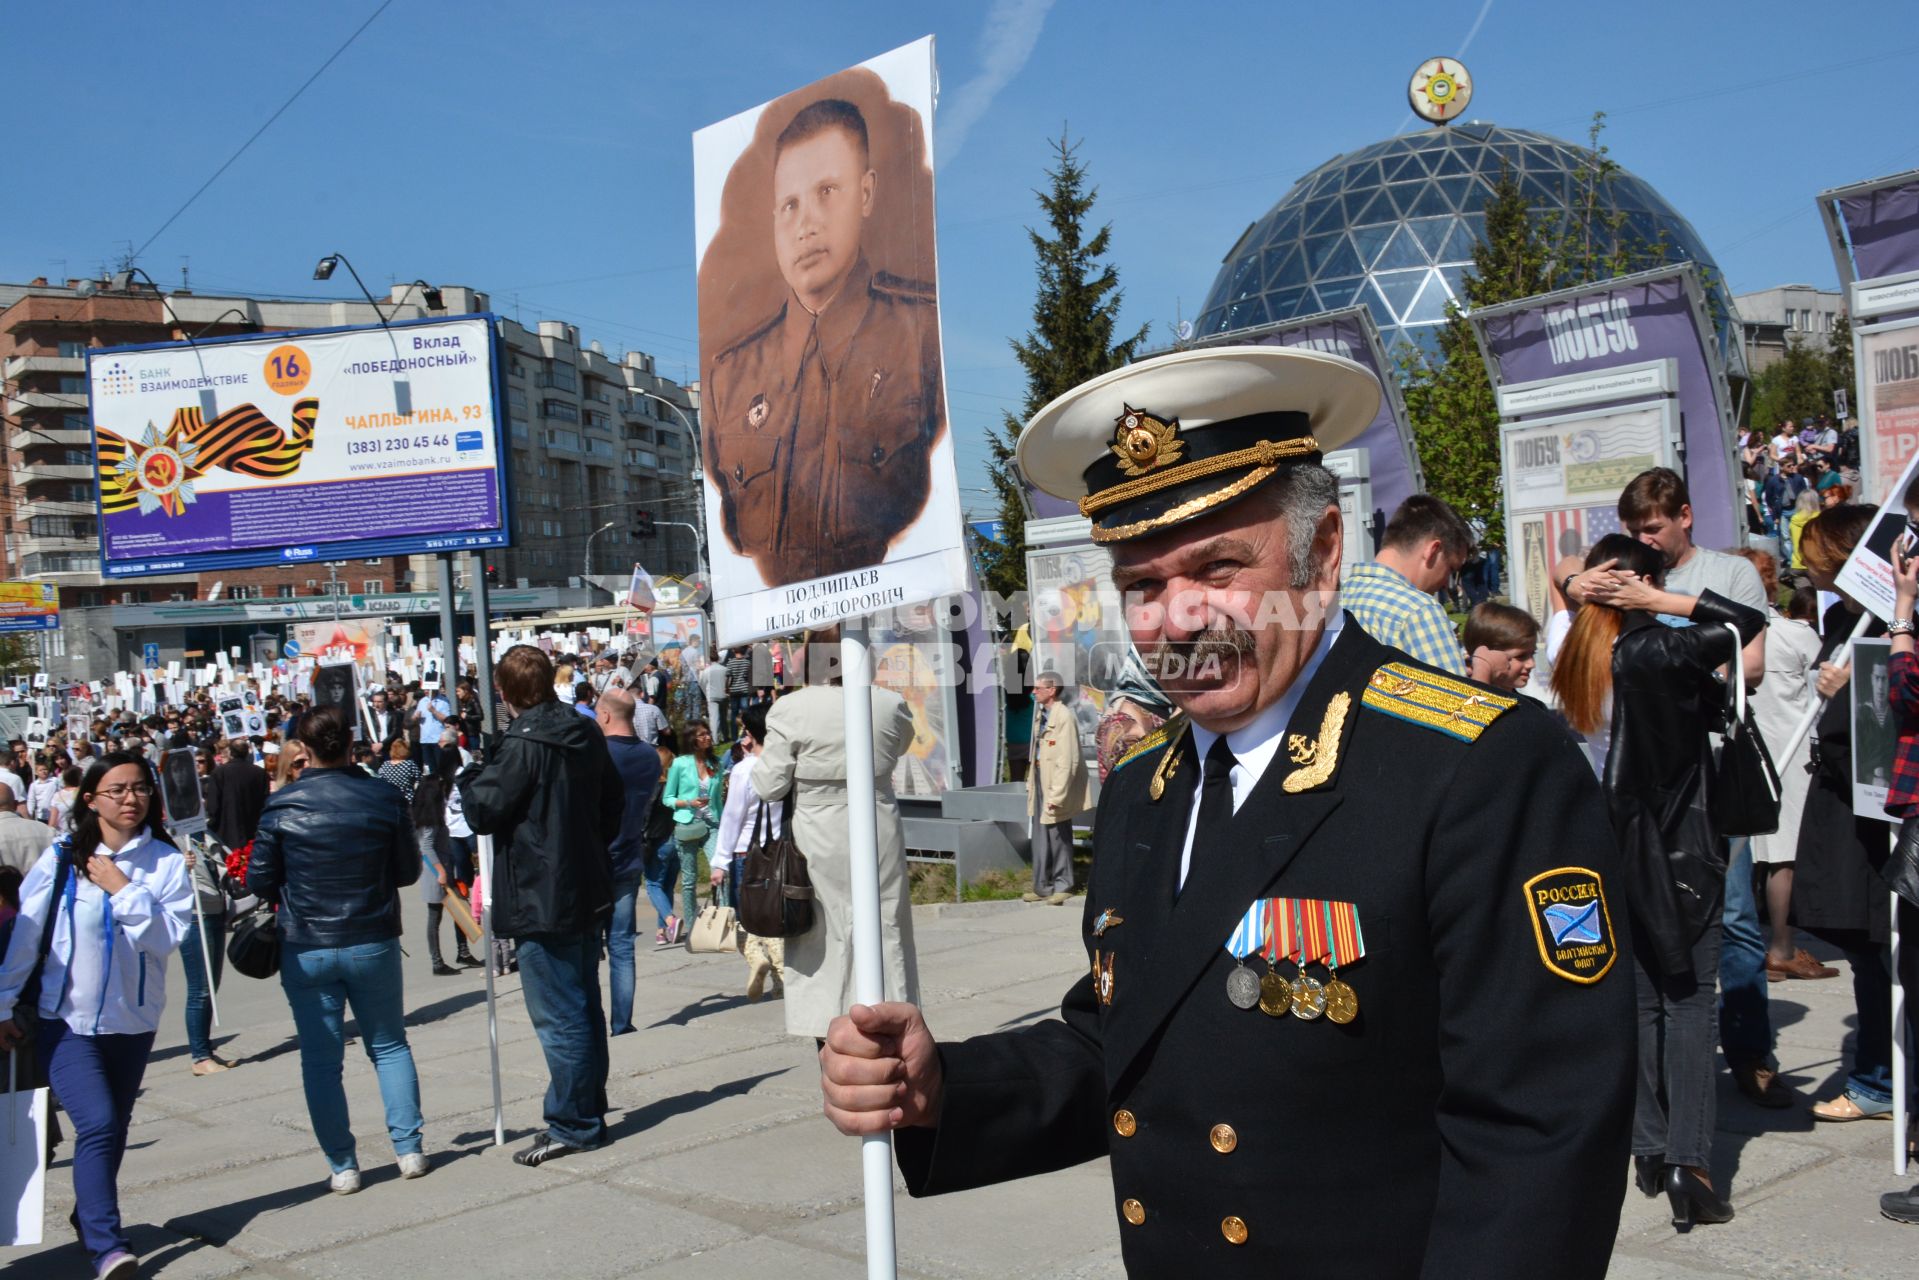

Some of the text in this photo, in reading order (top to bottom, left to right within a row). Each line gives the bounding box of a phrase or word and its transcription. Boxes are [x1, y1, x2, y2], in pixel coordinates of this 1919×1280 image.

[413, 336, 461, 350] Вклад
[140, 368, 171, 380] БАНК
[272, 354, 300, 379] 16
[343, 351, 477, 375] «ПОБЕДОНОСНЫЙ»
[140, 374, 248, 393] ВЗАИМОДЕЙСТВИЕ
[345, 405, 482, 430] ЧАПЛЫГИНА, 93
[347, 439, 381, 455] (383)
[386, 437, 410, 451] 230
[414, 435, 430, 448] 45
[433, 434, 449, 447] 46
[349, 456, 451, 473] www.vzaimobank.ru
[785, 569, 879, 605] ПОДЛИПАЕВ
[765, 586, 904, 632] ИЛЬЯ ФЁДОРОВИЧ
[1536, 882, 1598, 905] РОССИЯ
[1574, 957, 1595, 969] ФЛОТ
